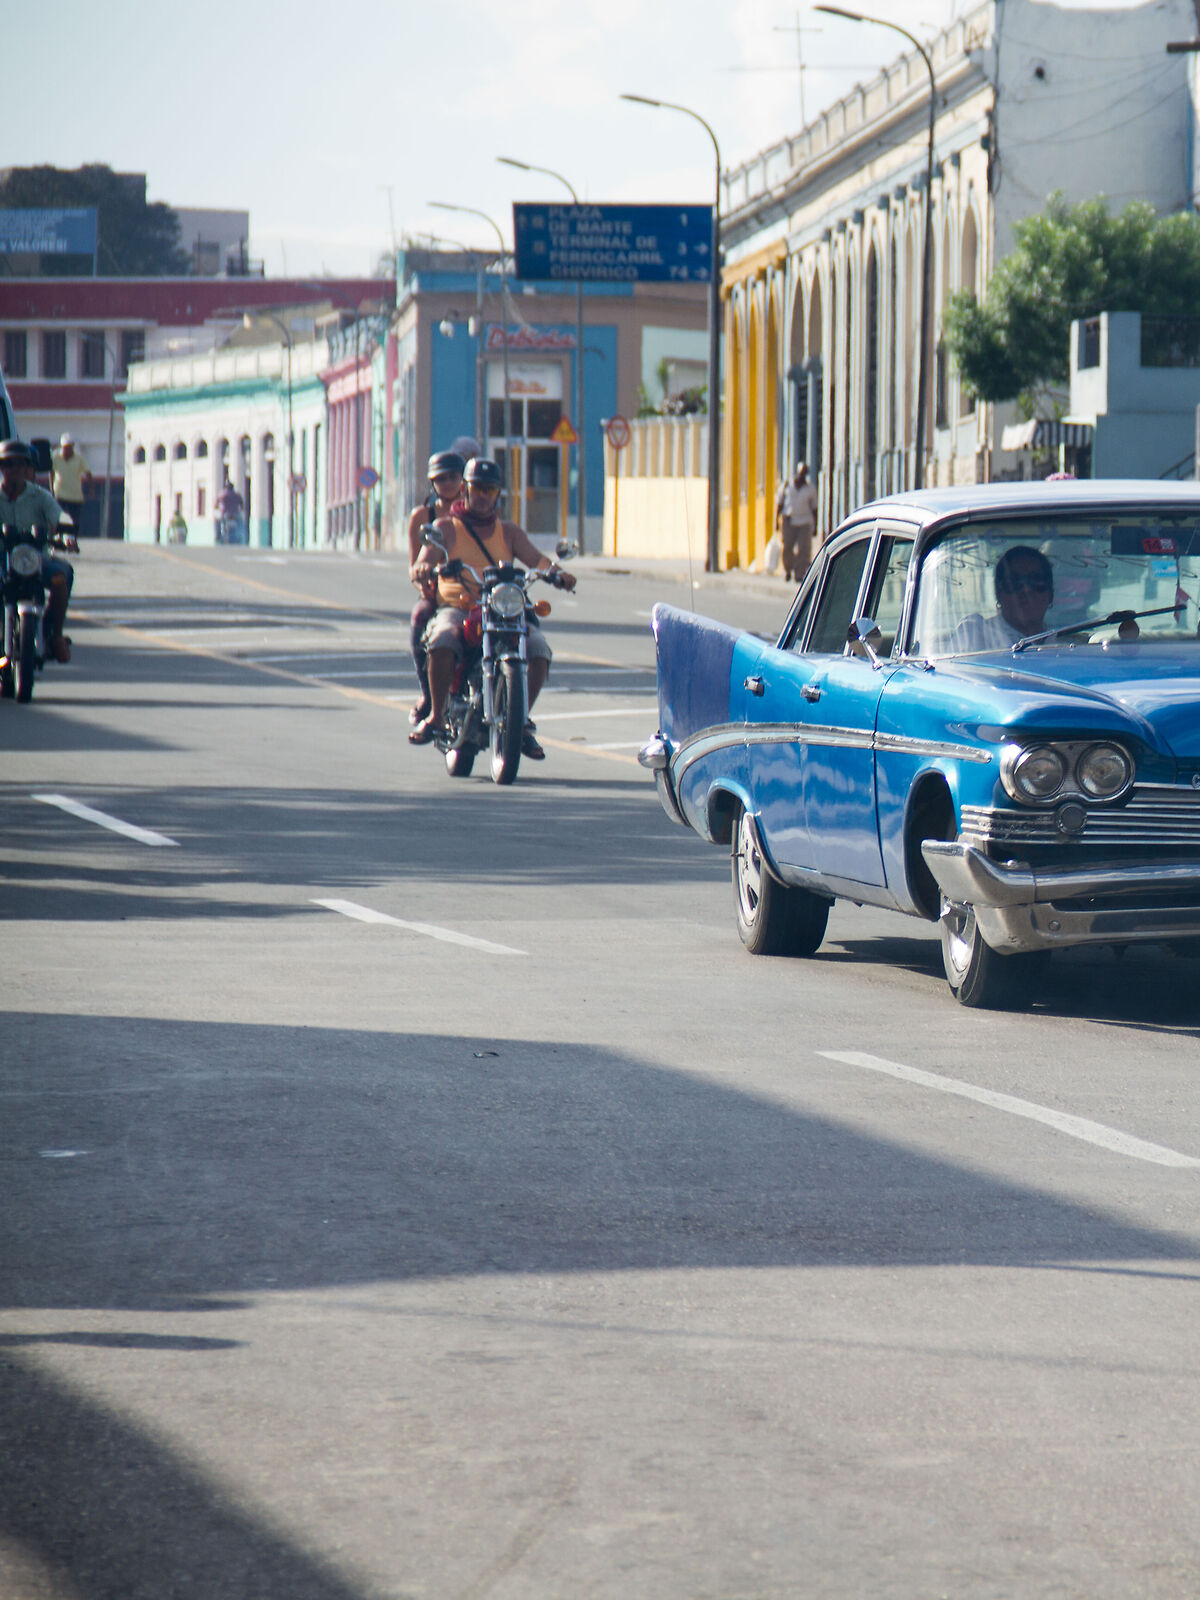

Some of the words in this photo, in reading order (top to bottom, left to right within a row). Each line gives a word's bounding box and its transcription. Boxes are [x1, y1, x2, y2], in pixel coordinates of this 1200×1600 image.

[549, 207, 602, 220] PLAZA
[679, 213, 688, 227] 1
[549, 221, 569, 233] DE
[576, 221, 633, 234] MARTE
[550, 236, 631, 249] TERMINAL
[636, 236, 658, 248] DE
[549, 251, 664, 265] FERROCARRIL
